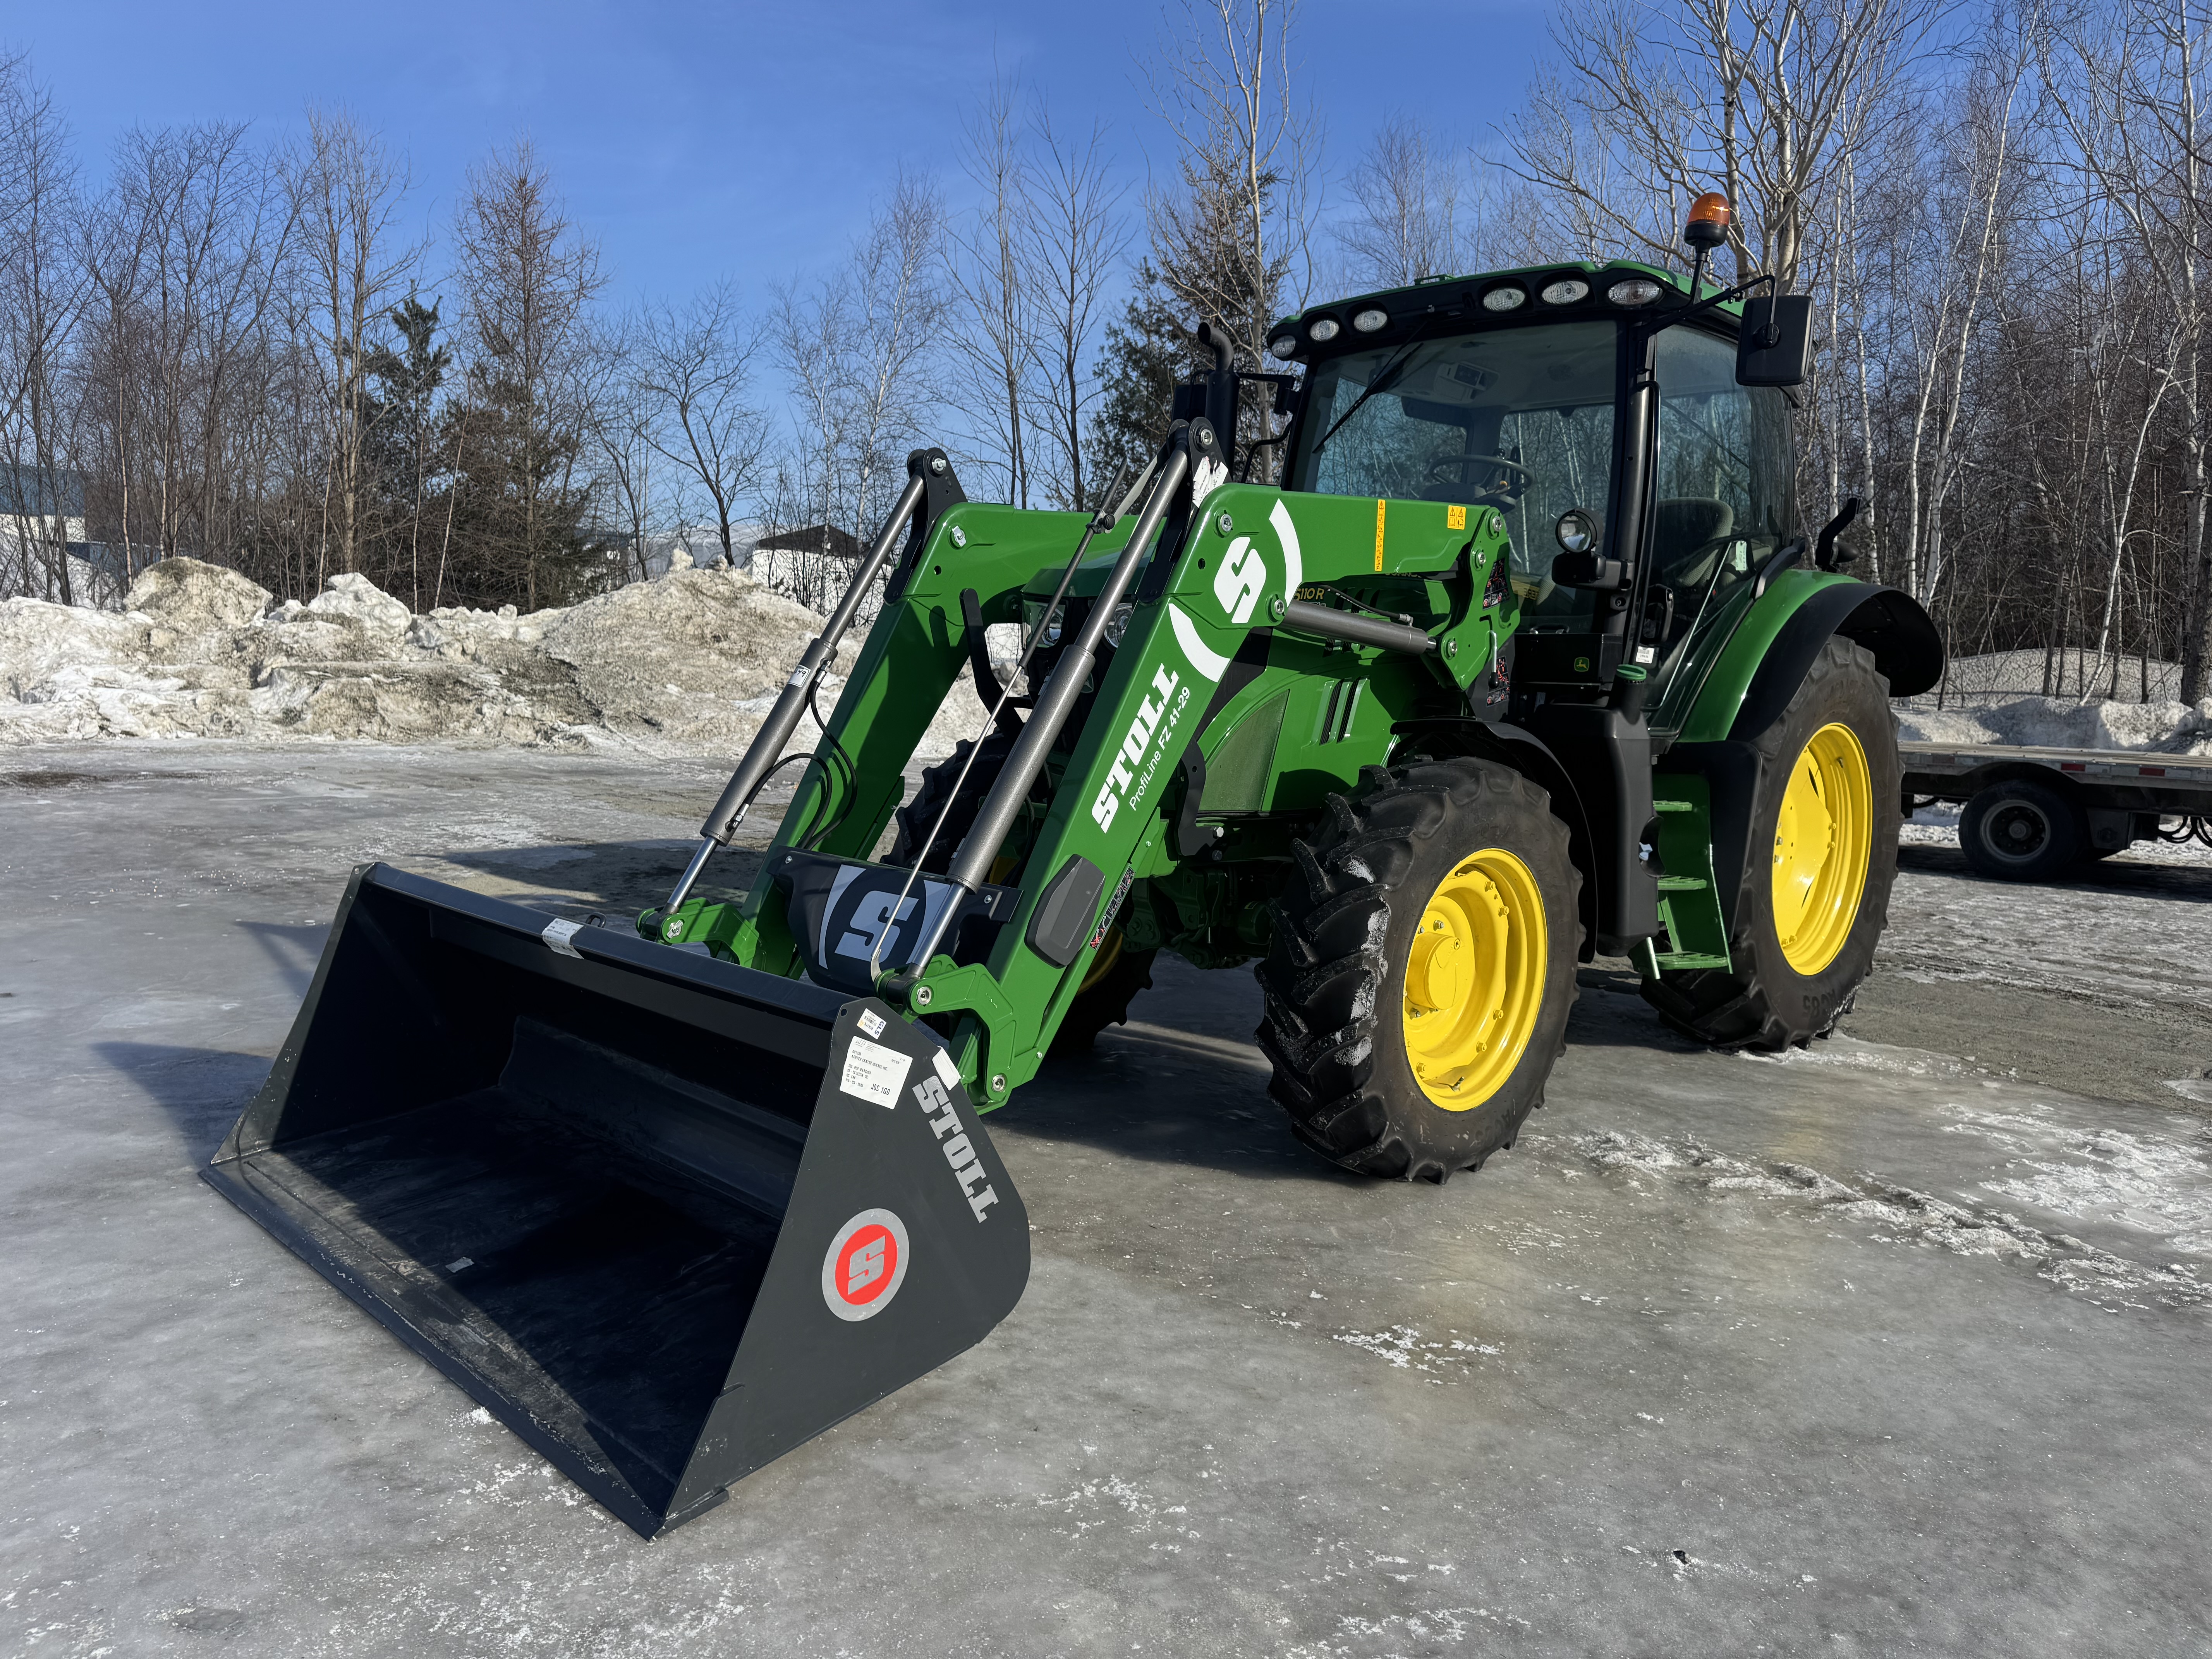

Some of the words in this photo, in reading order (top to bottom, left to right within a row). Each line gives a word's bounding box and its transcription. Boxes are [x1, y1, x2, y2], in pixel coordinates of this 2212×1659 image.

[1091, 663, 1180, 834] STOLL
[1129, 750, 1161, 811] ProfiLine
[1158, 725, 1172, 750] FZ
[1170, 686, 1191, 725] 41-29
[874, 1021, 884, 1035] GLS
[912, 1075, 999, 1223] STOLL
